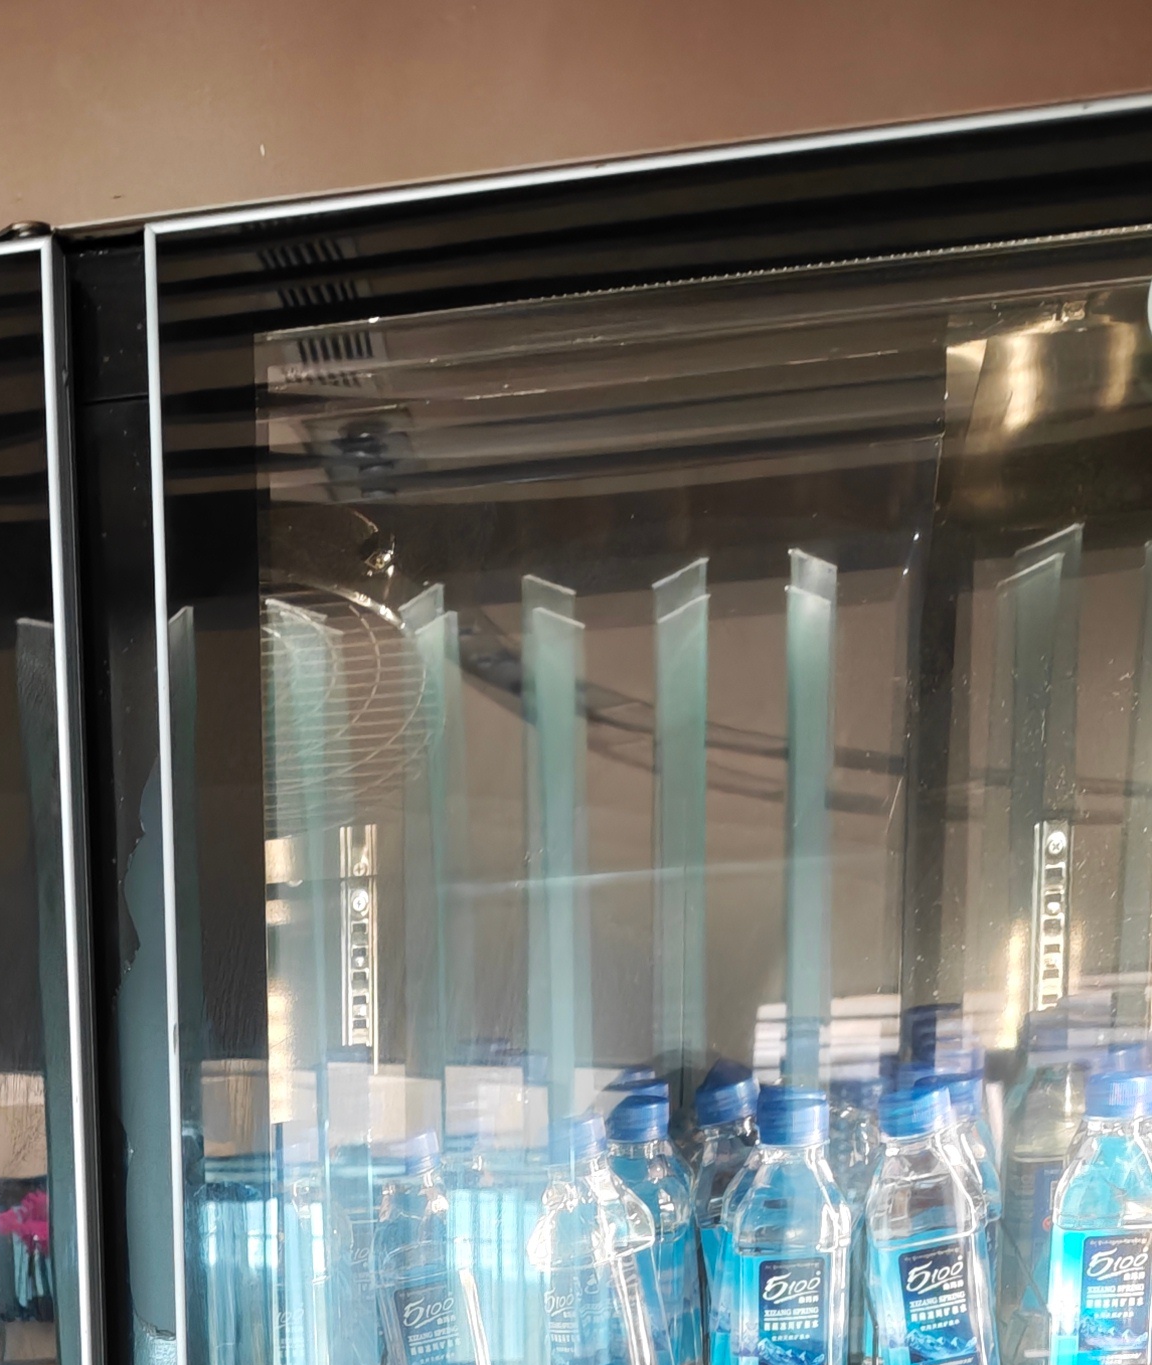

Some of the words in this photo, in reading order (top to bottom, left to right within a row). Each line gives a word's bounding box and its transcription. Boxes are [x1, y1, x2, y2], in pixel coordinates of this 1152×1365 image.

[906, 1260, 964, 1293] 5100
[1086, 1247, 1149, 1279] 5100
[762, 1272, 822, 1304] 5100
[403, 1297, 455, 1327] 5100
[764, 1308, 792, 1317] XIZANG
[793, 1306, 819, 1316] SPRING
